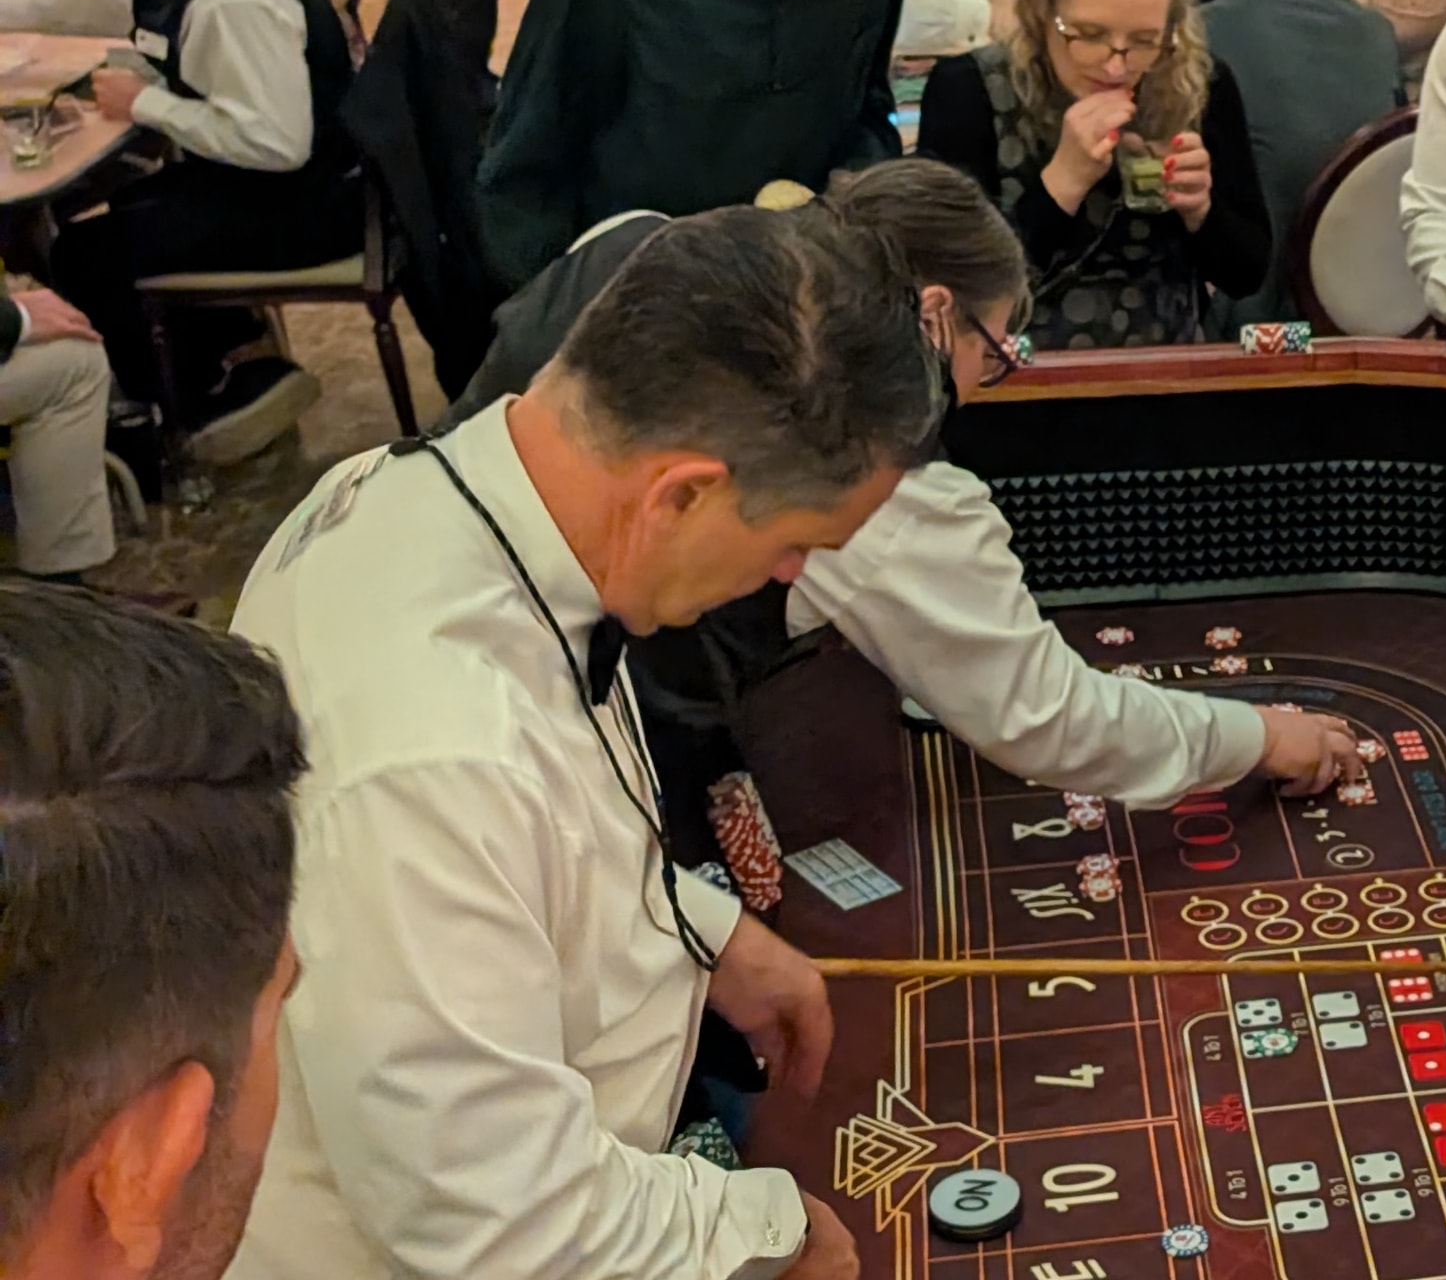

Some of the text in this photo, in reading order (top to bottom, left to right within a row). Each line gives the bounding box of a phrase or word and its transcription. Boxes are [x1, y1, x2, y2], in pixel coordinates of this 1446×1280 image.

[1012, 818, 1073, 841] 8
[1335, 849, 1365, 864] 2
[1028, 976, 1096, 997] 5
[1034, 1064, 1104, 1088] 4
[954, 1179, 997, 1212] ON
[1042, 1163, 1120, 1212] 10
